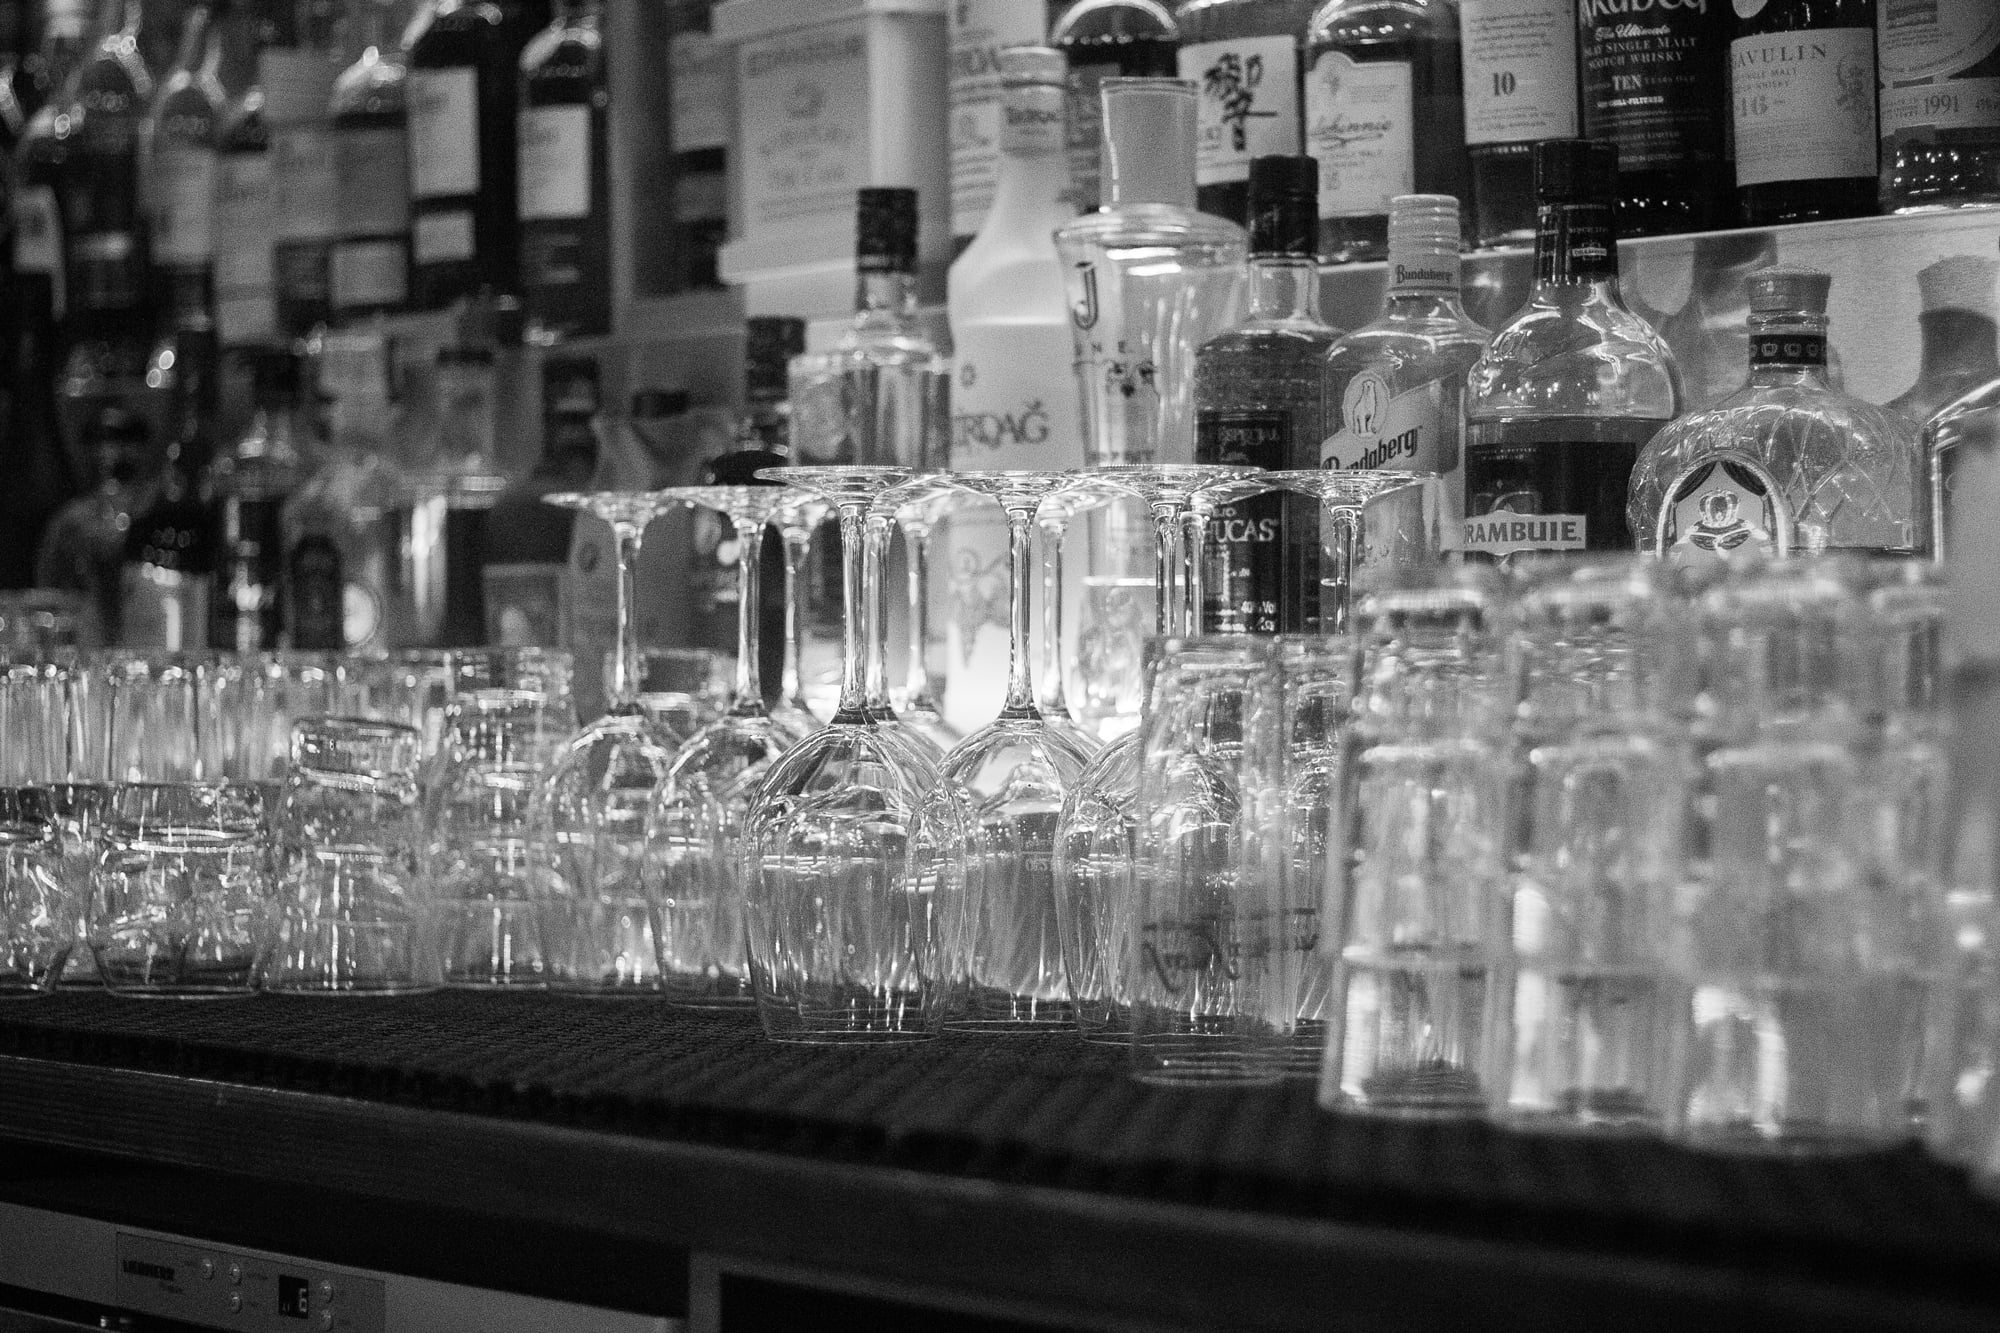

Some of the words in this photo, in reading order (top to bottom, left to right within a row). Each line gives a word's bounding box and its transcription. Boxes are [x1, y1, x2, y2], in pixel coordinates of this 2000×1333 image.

[1658, 37, 1696, 48] MALT
[1629, 51, 1682, 63] WHISKY
[1731, 44, 1827, 68] AVULIN
[1493, 71, 1516, 96] 10
[1612, 74, 1642, 91] TEN
[1740, 95, 1769, 117] 16
[1924, 94, 1959, 115] 1991
[1321, 426, 1418, 470] daberg
